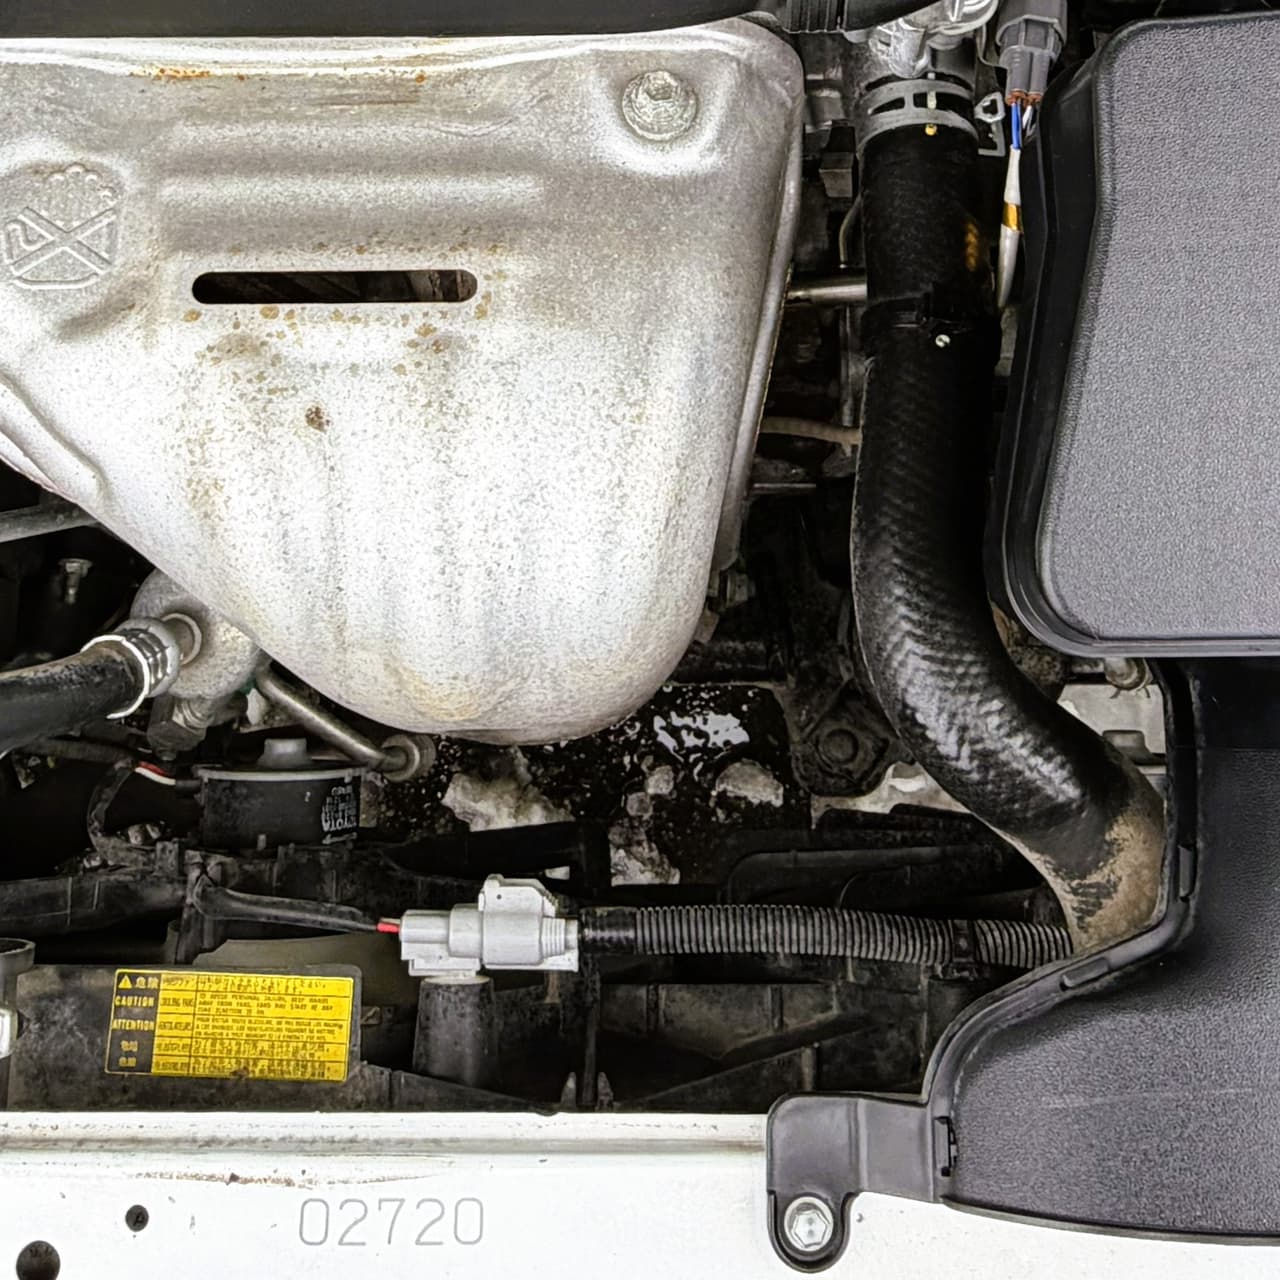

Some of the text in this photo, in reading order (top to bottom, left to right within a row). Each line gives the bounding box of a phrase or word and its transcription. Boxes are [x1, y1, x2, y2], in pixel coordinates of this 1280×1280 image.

[114, 995, 155, 1007] CAUTION
[111, 1018, 155, 1031] ATTENTION
[298, 1197, 484, 1246] 02720
